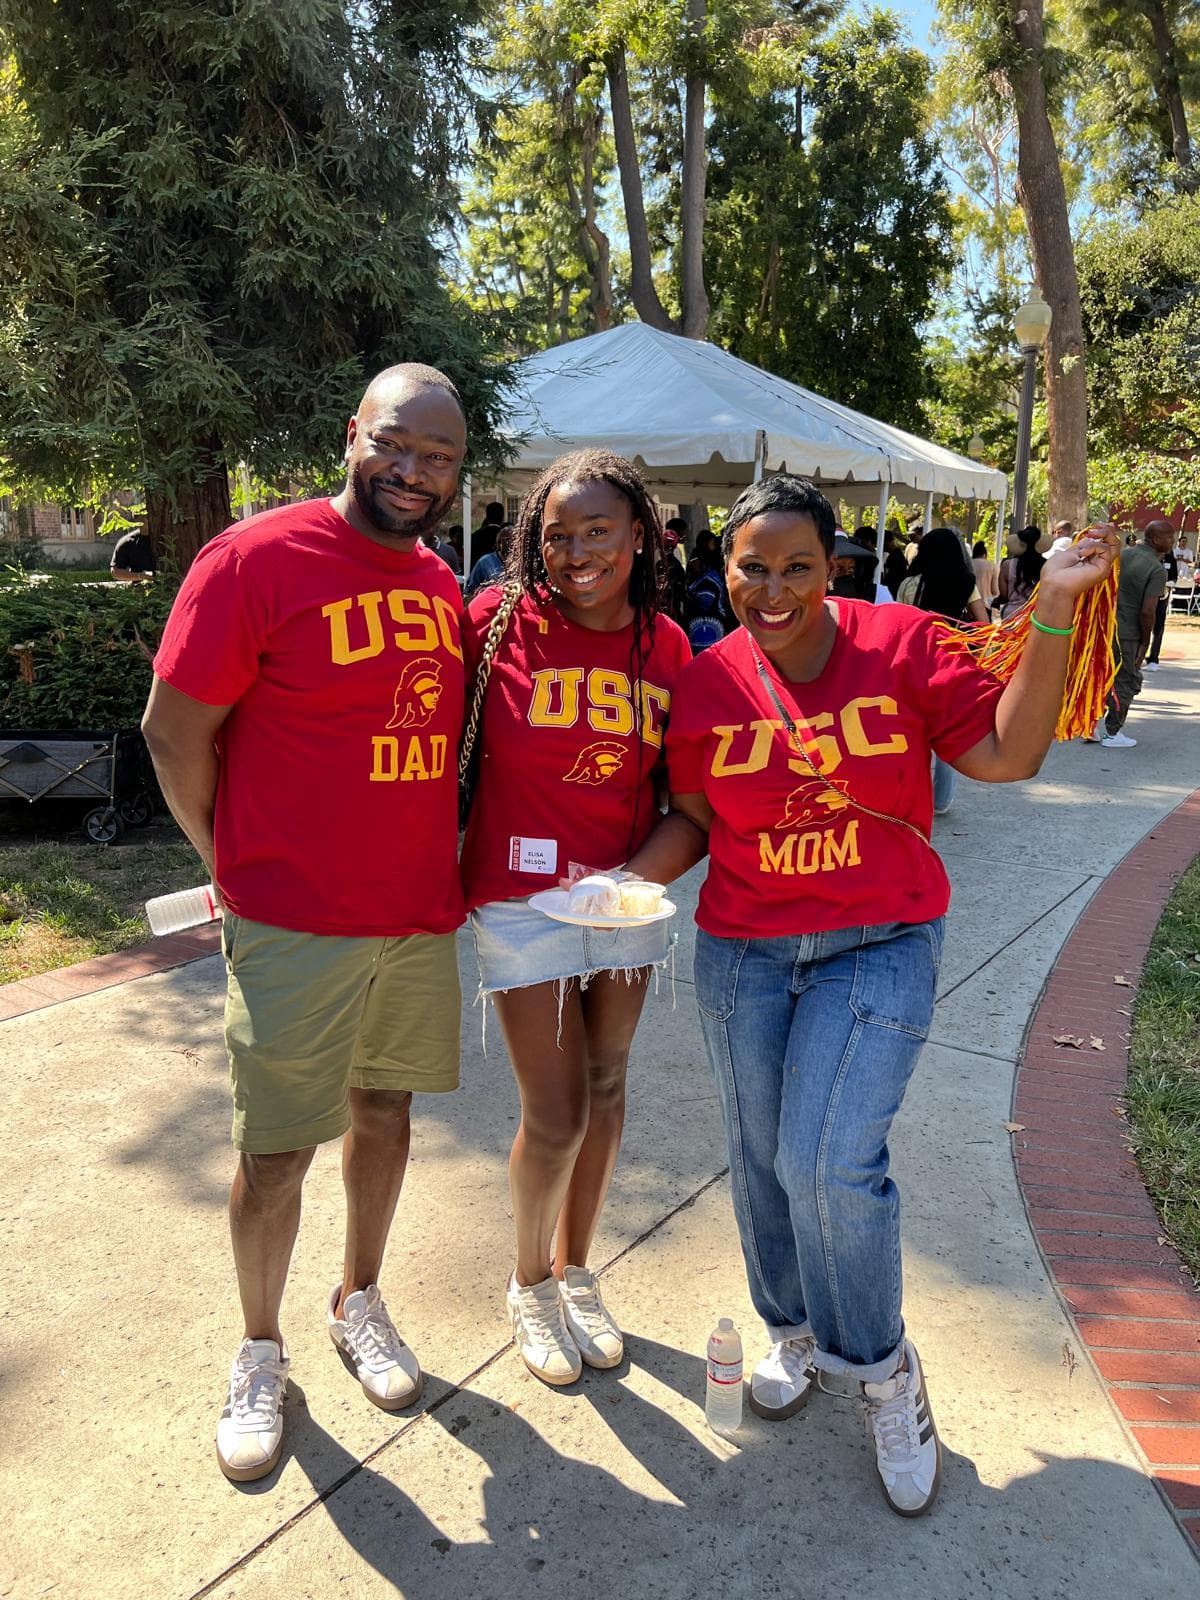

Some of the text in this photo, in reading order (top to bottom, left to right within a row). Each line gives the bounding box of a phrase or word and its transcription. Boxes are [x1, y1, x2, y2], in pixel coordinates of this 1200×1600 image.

[527, 667, 671, 750] USC
[710, 695, 909, 778] USC
[369, 734, 448, 782] DAD
[758, 819, 861, 875] MOM
